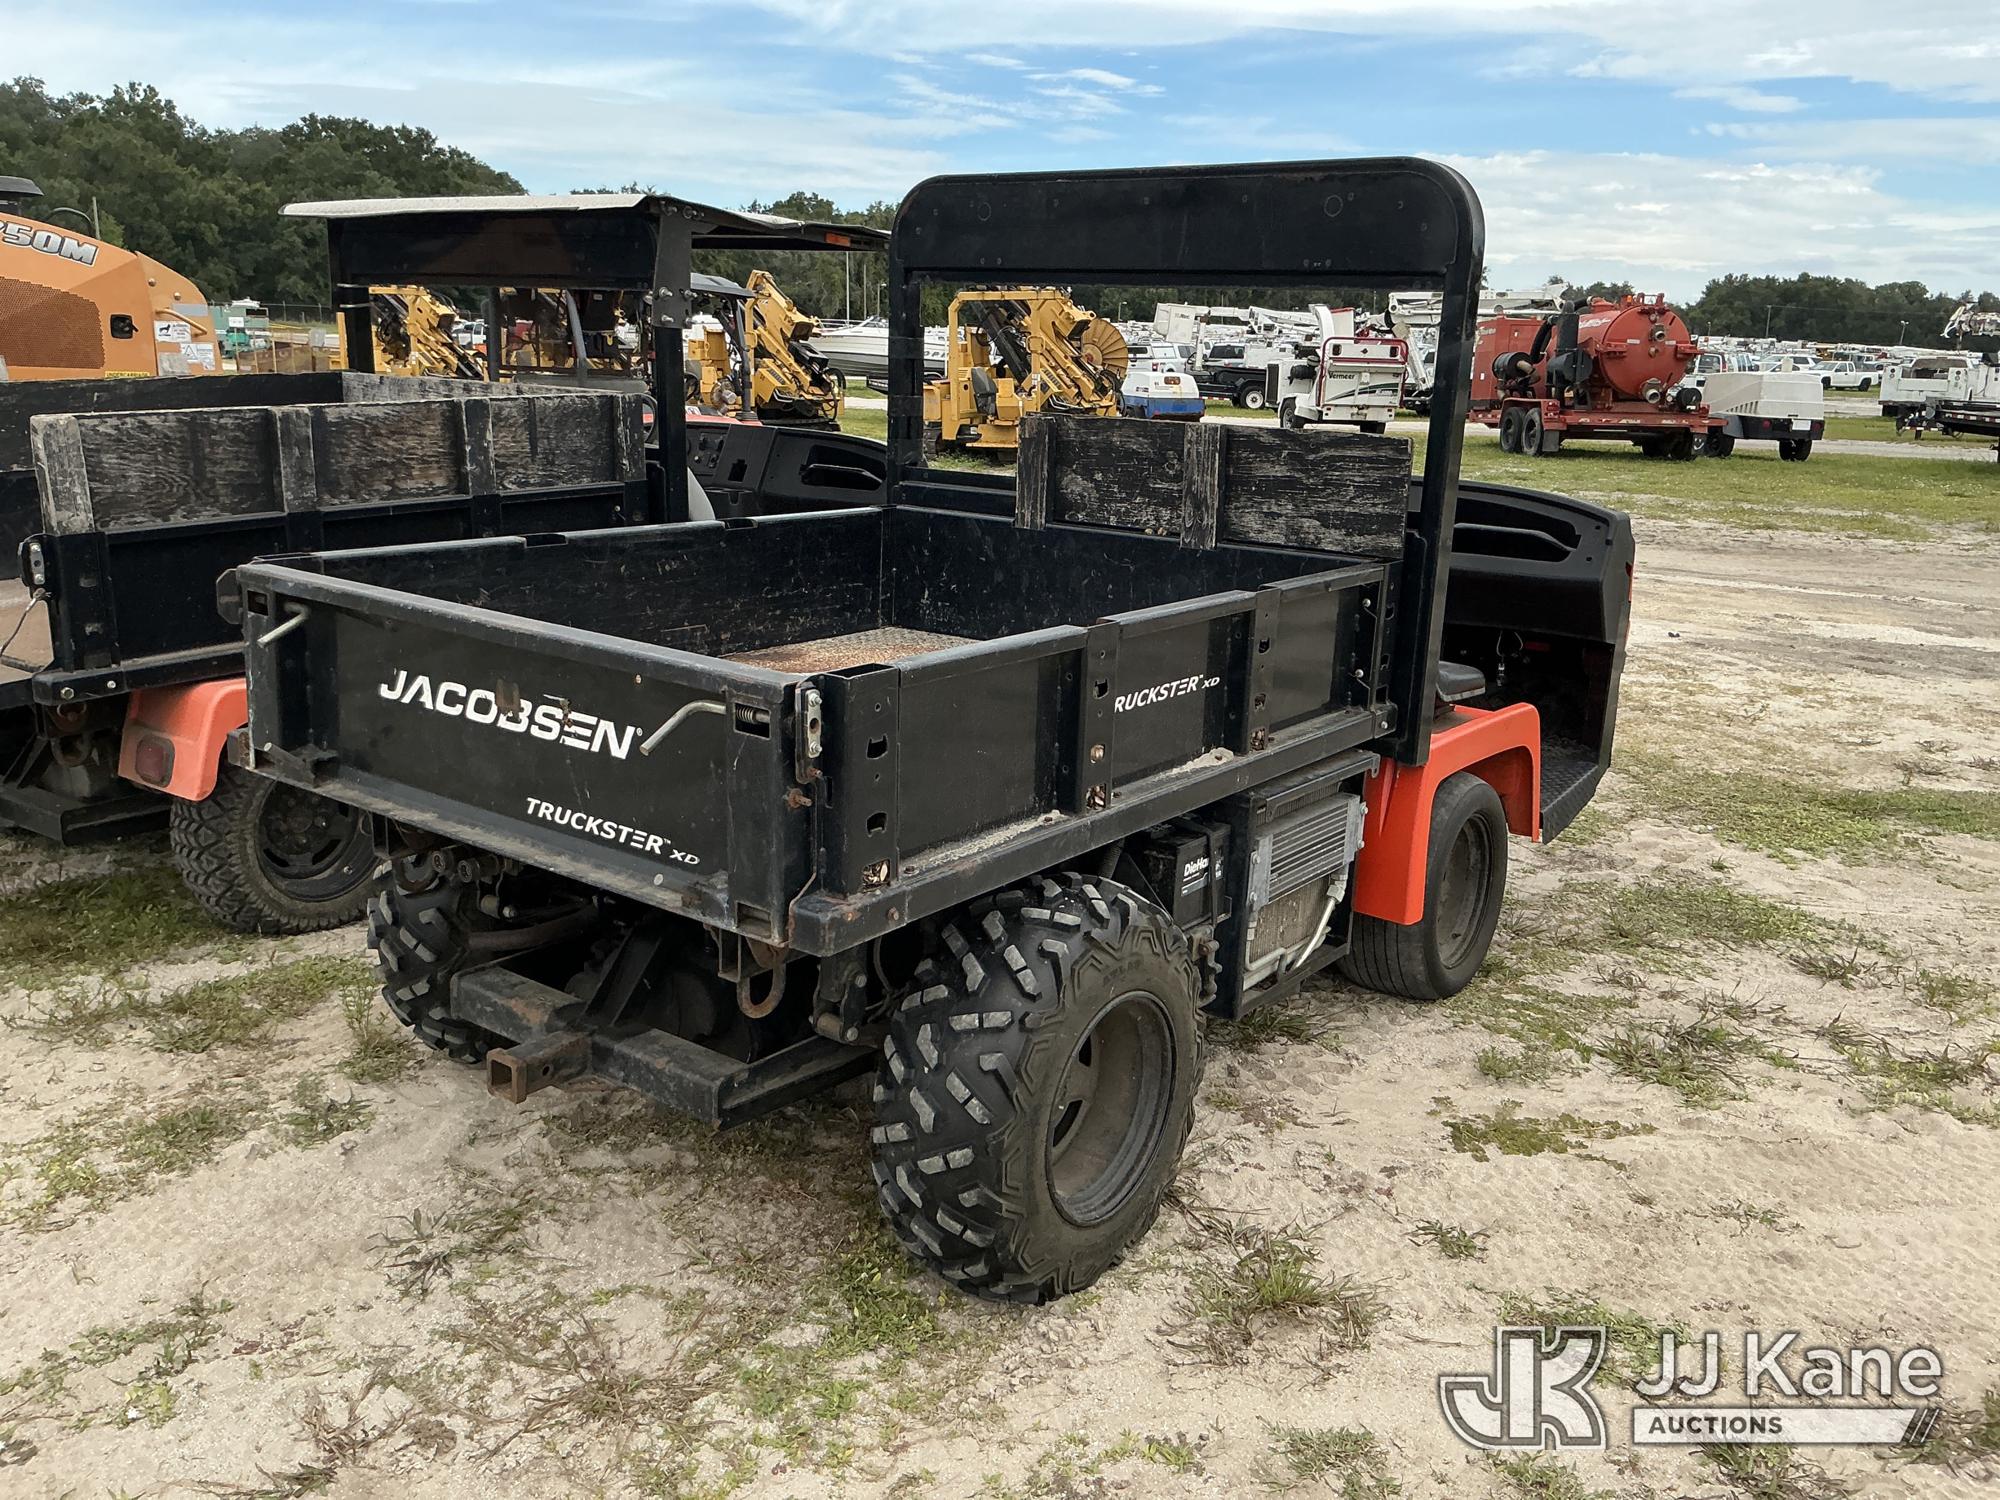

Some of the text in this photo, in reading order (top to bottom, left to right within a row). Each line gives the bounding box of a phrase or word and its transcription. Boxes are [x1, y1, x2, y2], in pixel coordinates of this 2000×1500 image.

[0, 220, 98, 267] 50M
[1328, 371, 1355, 380] Vermeer
[1114, 675, 1220, 713] RUCKSTER XD
[378, 669, 636, 760] JACOBSEN
[669, 848, 701, 866] XD
